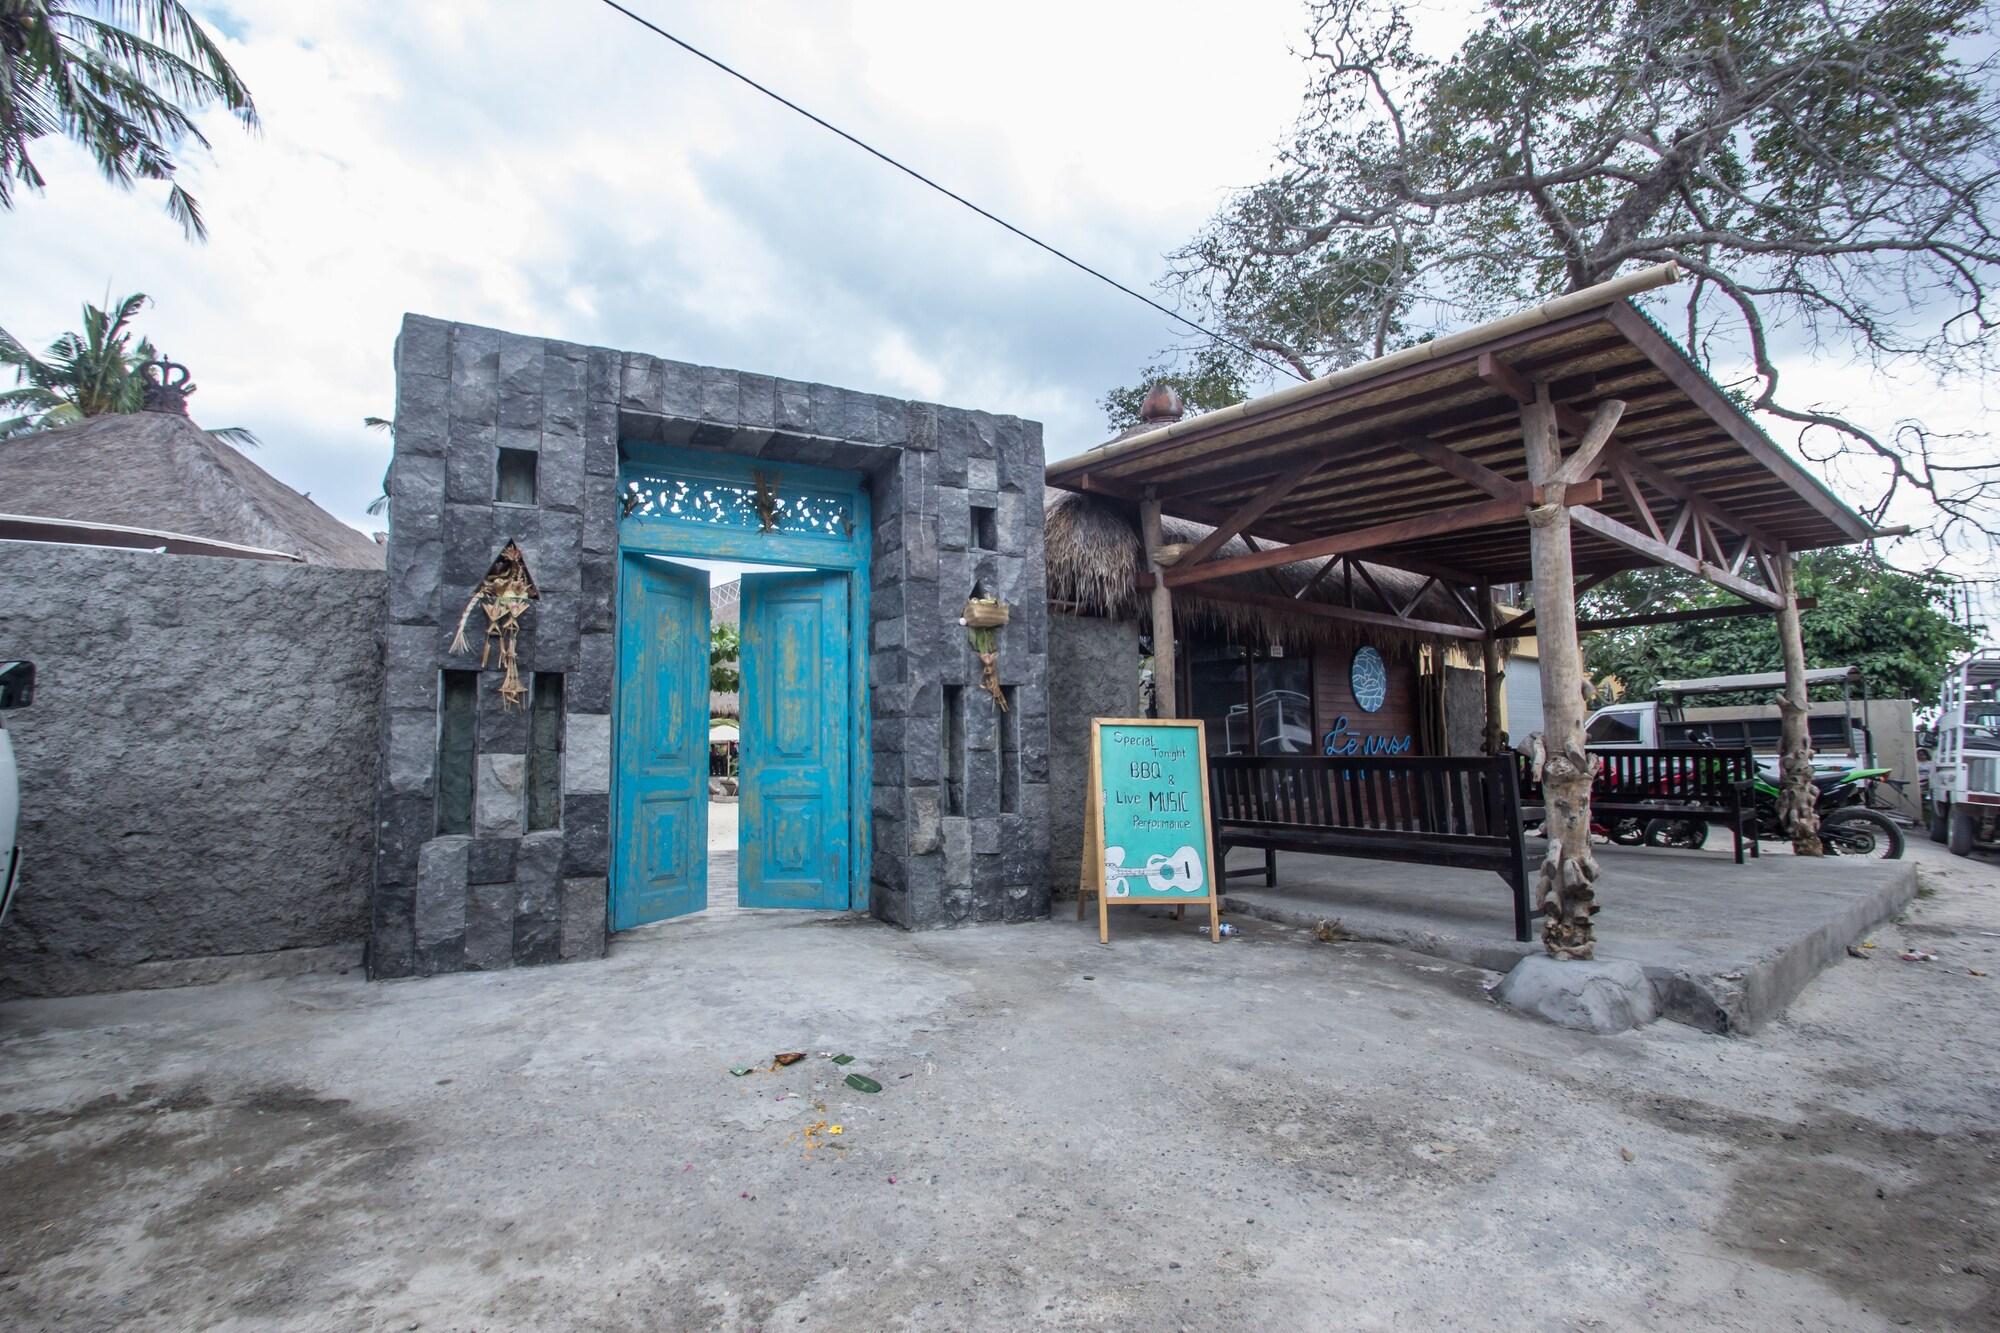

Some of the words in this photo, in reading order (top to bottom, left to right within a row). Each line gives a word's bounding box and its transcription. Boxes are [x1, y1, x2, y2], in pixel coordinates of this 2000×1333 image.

[1113, 731, 1155, 748] Special
[1151, 746, 1186, 762] Tonight
[1130, 761, 1161, 779] BBQ
[1168, 774, 1175, 785] &
[1116, 790, 1141, 804] Live
[1149, 791, 1189, 812] MUSIC
[1133, 814, 1191, 833] Performance
